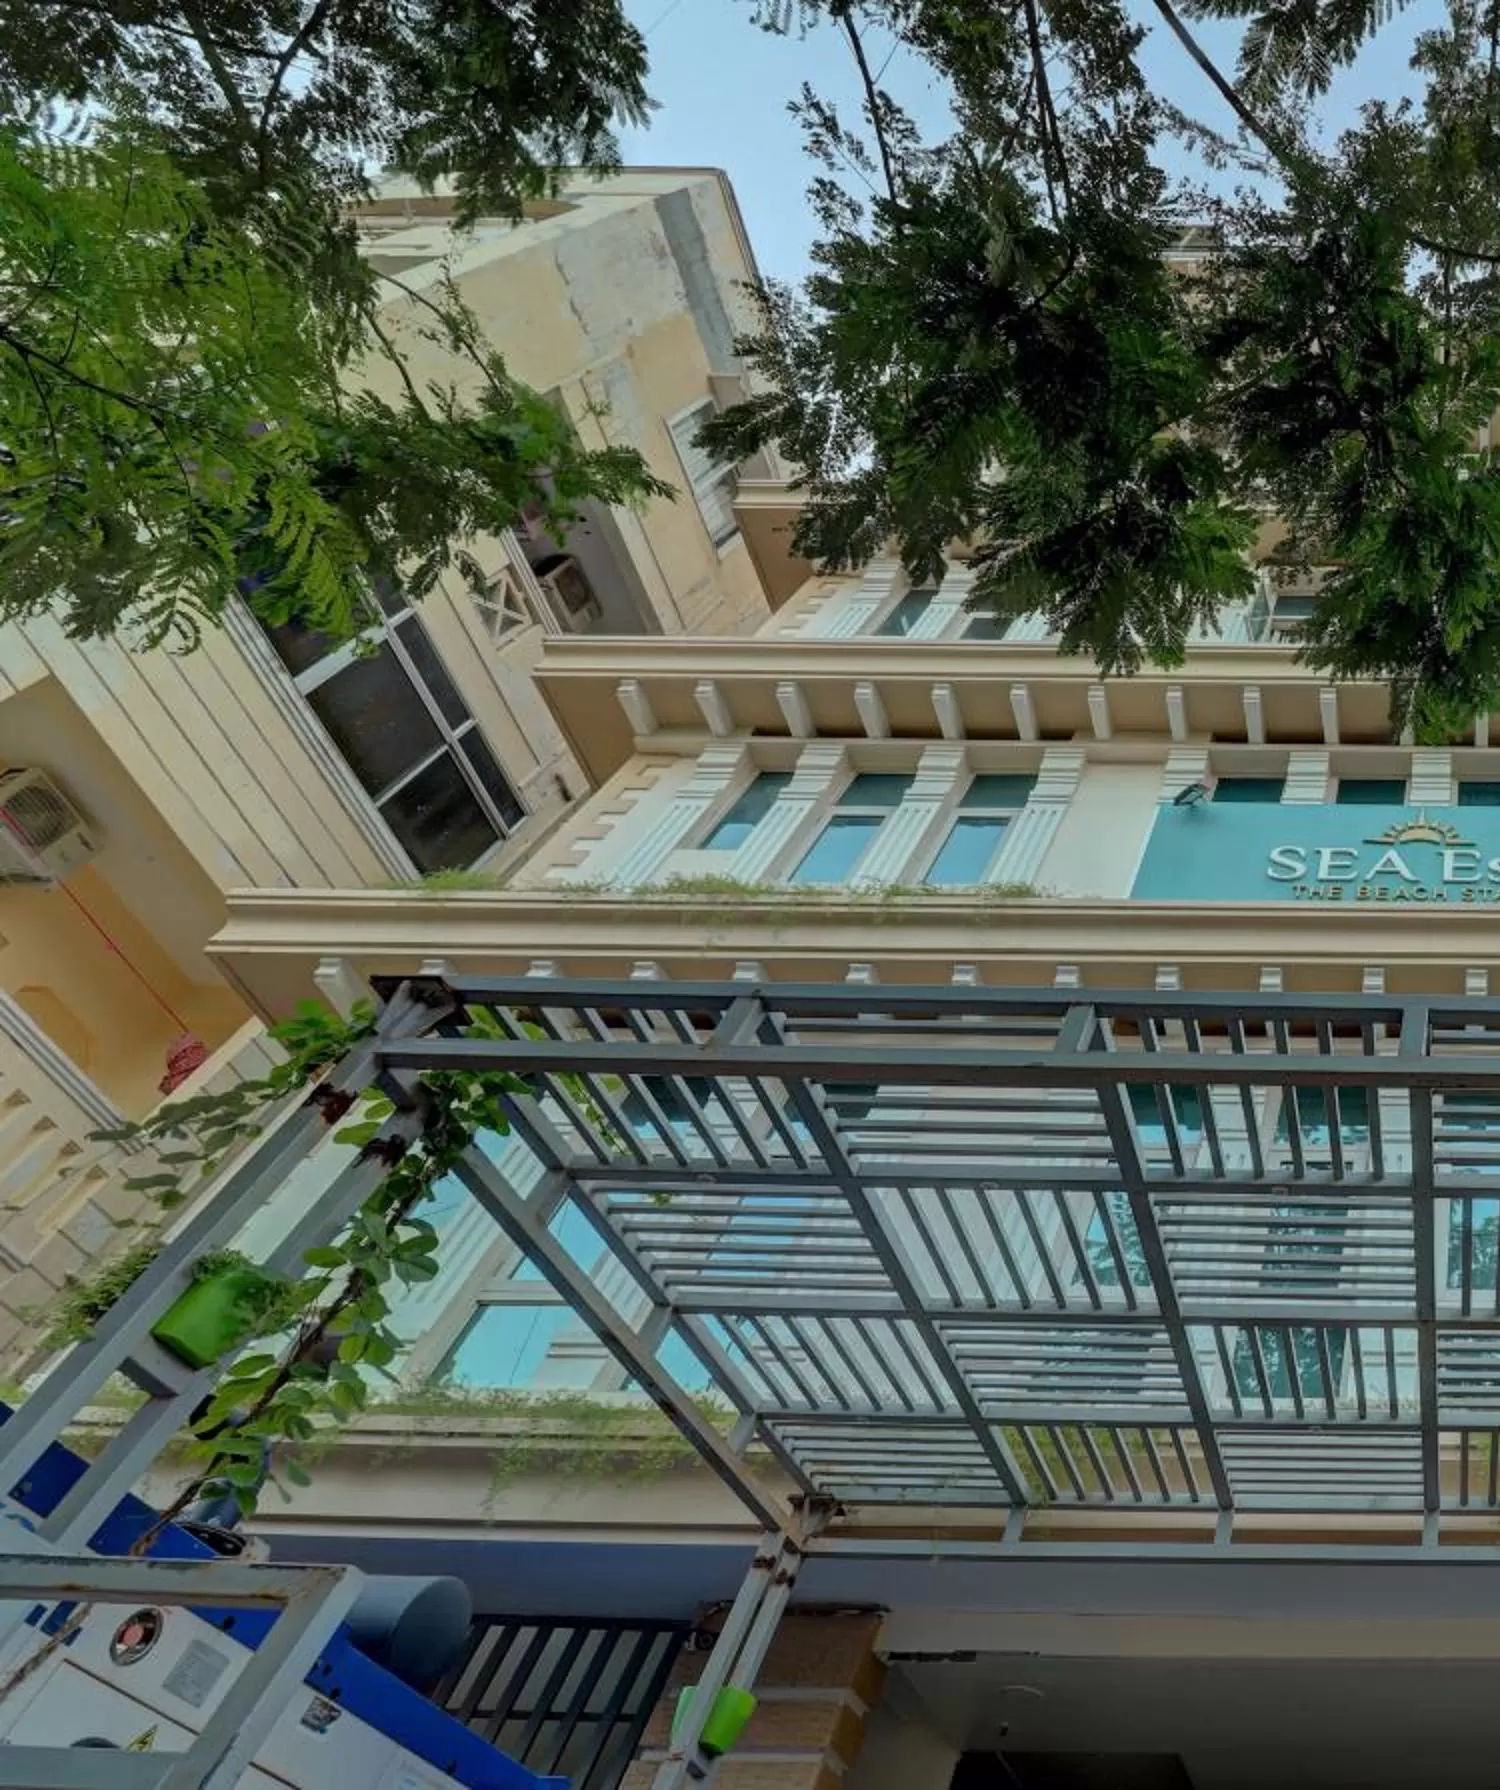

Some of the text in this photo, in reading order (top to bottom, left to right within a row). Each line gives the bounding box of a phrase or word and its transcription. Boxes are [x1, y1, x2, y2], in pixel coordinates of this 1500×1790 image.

[1267, 845, 1420, 882] SEA
[1293, 884, 1343, 900] THE
[1357, 884, 1448, 901] BEACH
